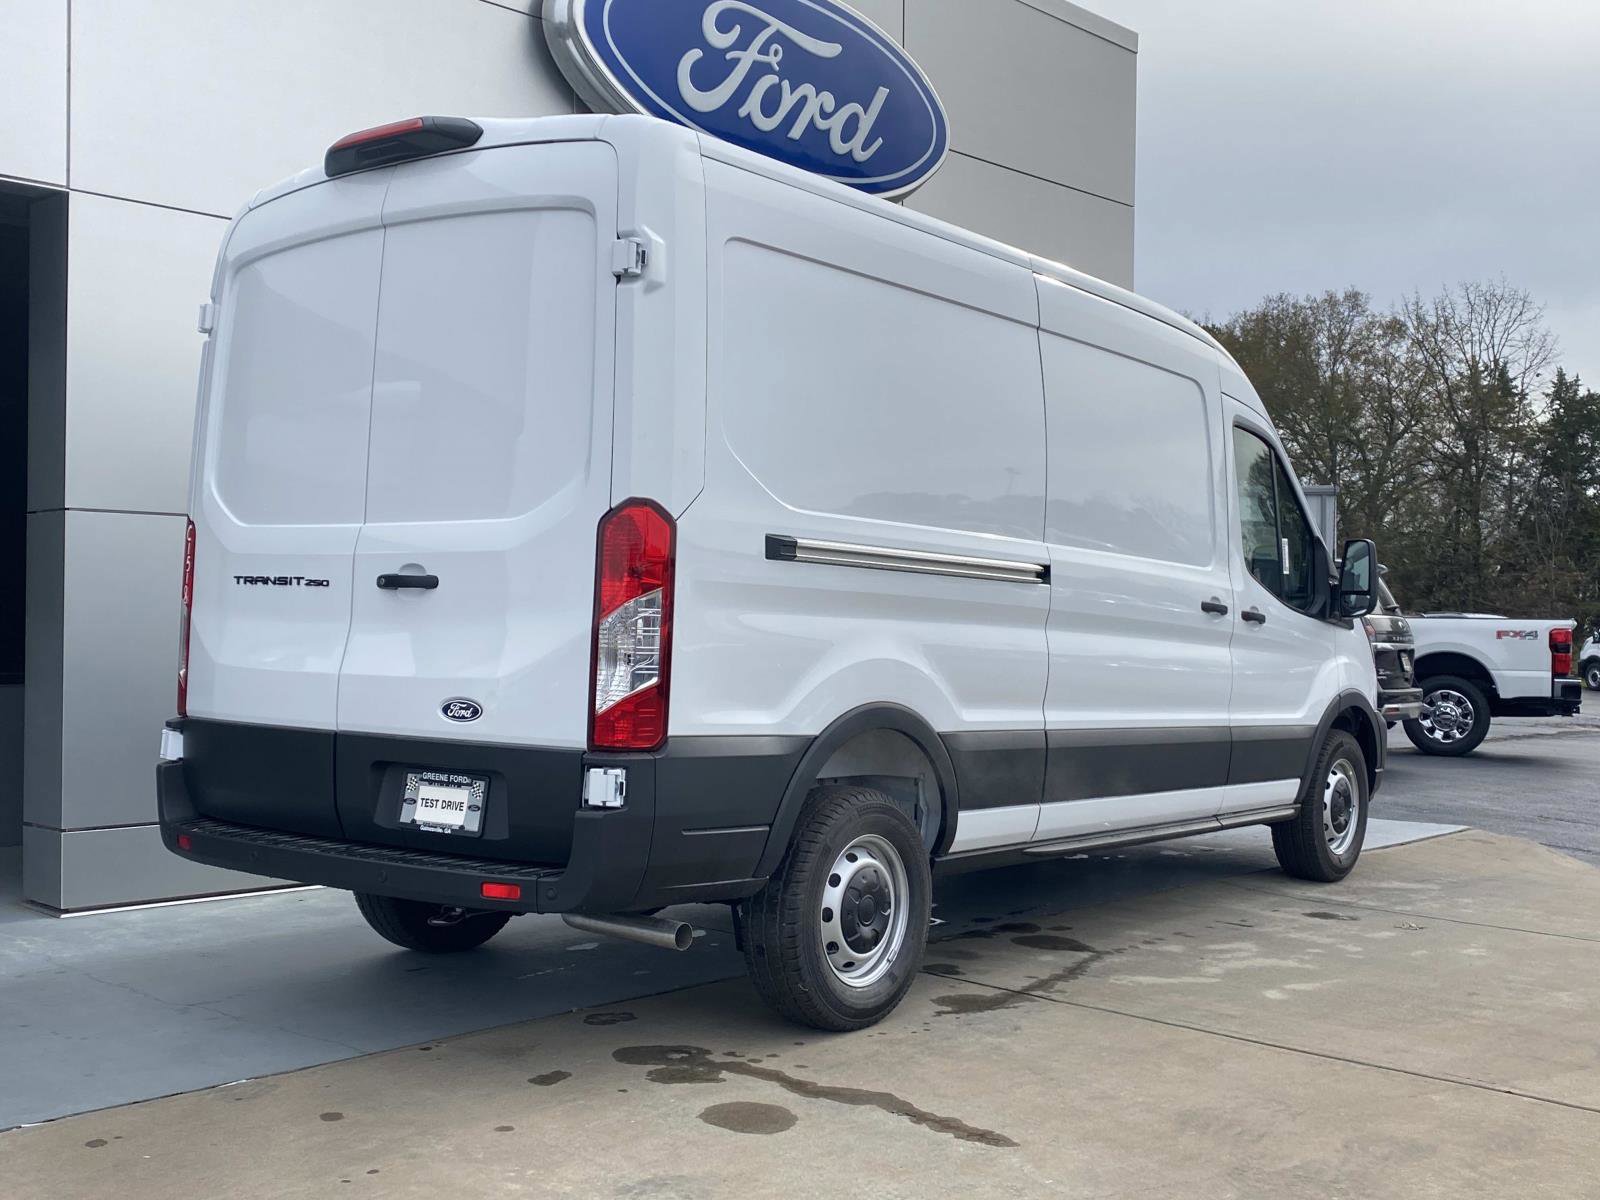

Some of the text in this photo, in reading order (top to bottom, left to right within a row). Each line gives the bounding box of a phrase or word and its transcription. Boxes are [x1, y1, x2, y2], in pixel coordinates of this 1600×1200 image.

[677, 0, 889, 162] Ford
[233, 576, 304, 586] TRANSIT
[448, 703, 473, 717] Ford
[422, 772, 449, 781] GREENE
[421, 798, 439, 808] TEST
[441, 800, 464, 811] DRIVE
